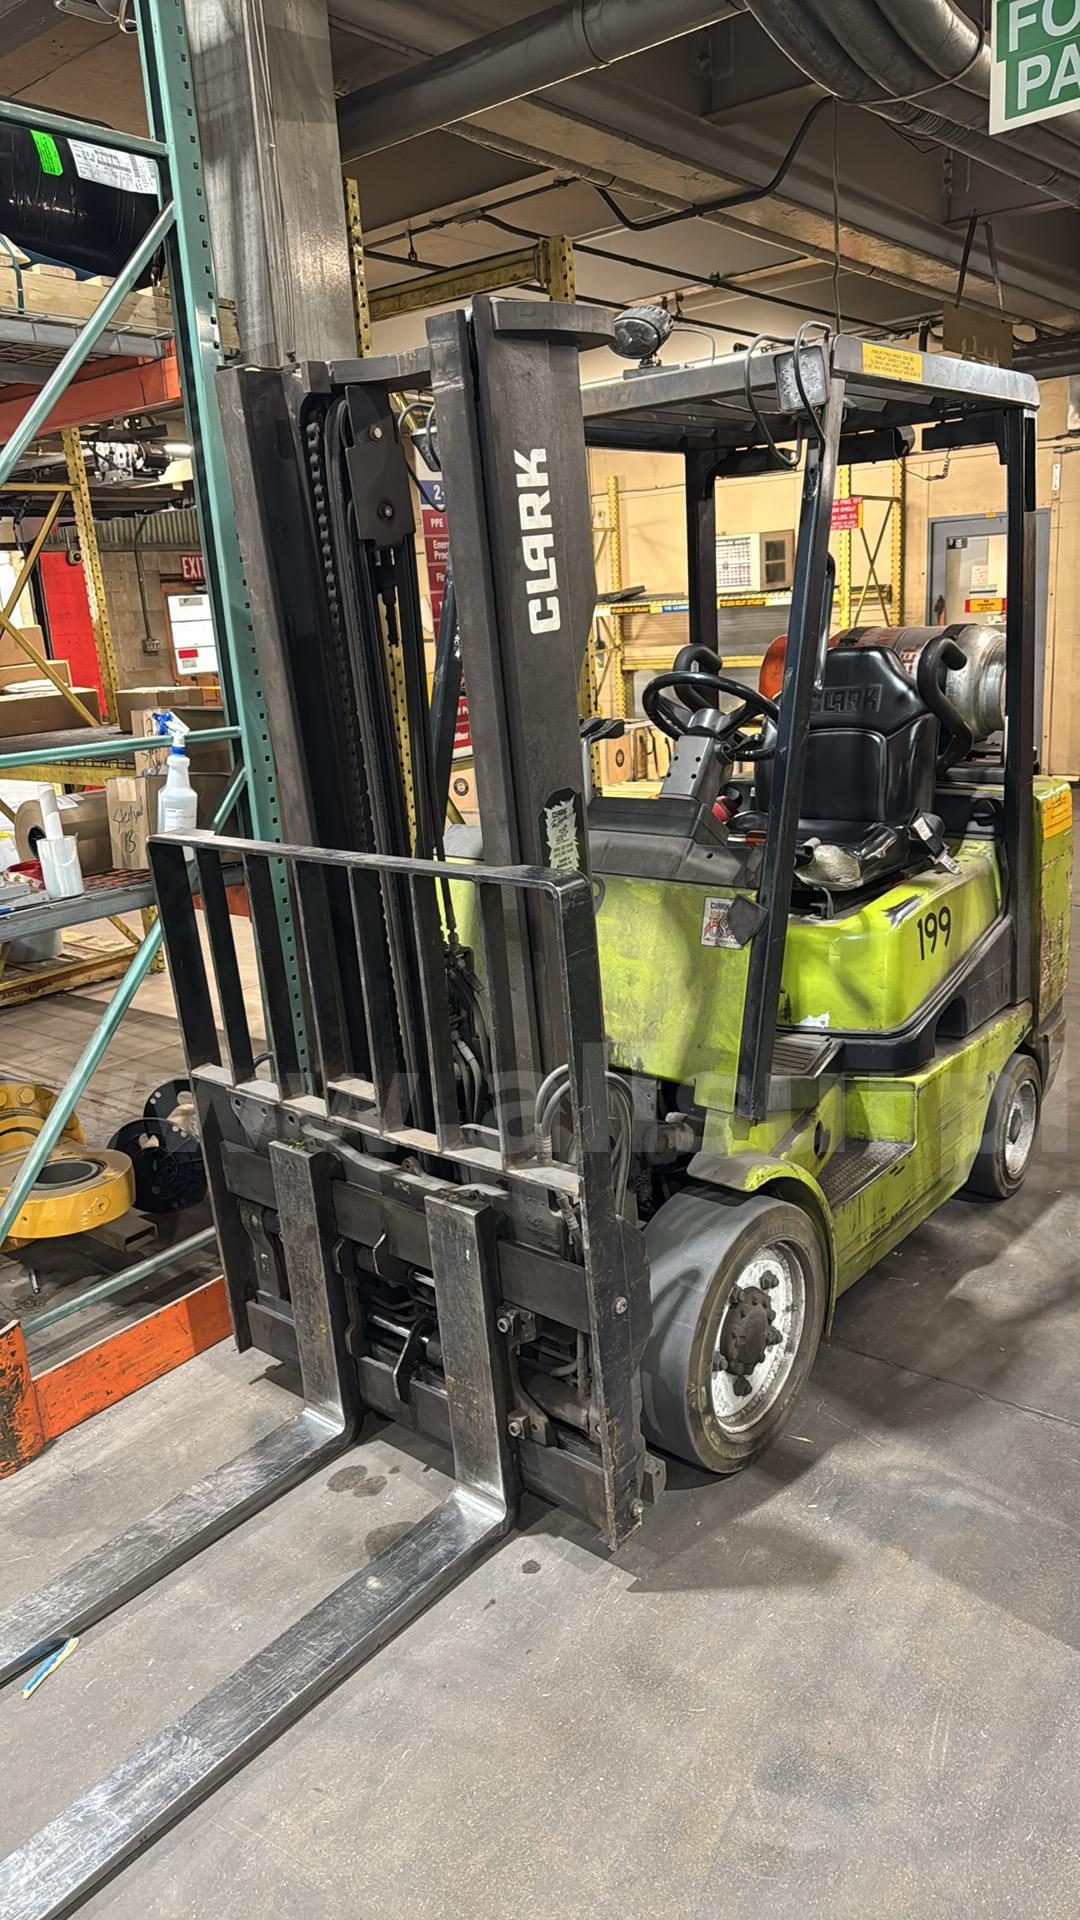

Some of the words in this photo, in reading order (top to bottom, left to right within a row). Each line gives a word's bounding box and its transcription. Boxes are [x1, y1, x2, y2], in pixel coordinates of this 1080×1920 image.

[1017, 43, 1080, 110] PA
[430, 518, 444, 528] PPE
[514, 448, 561, 635] CLARK
[917, 906, 952, 961] 199
